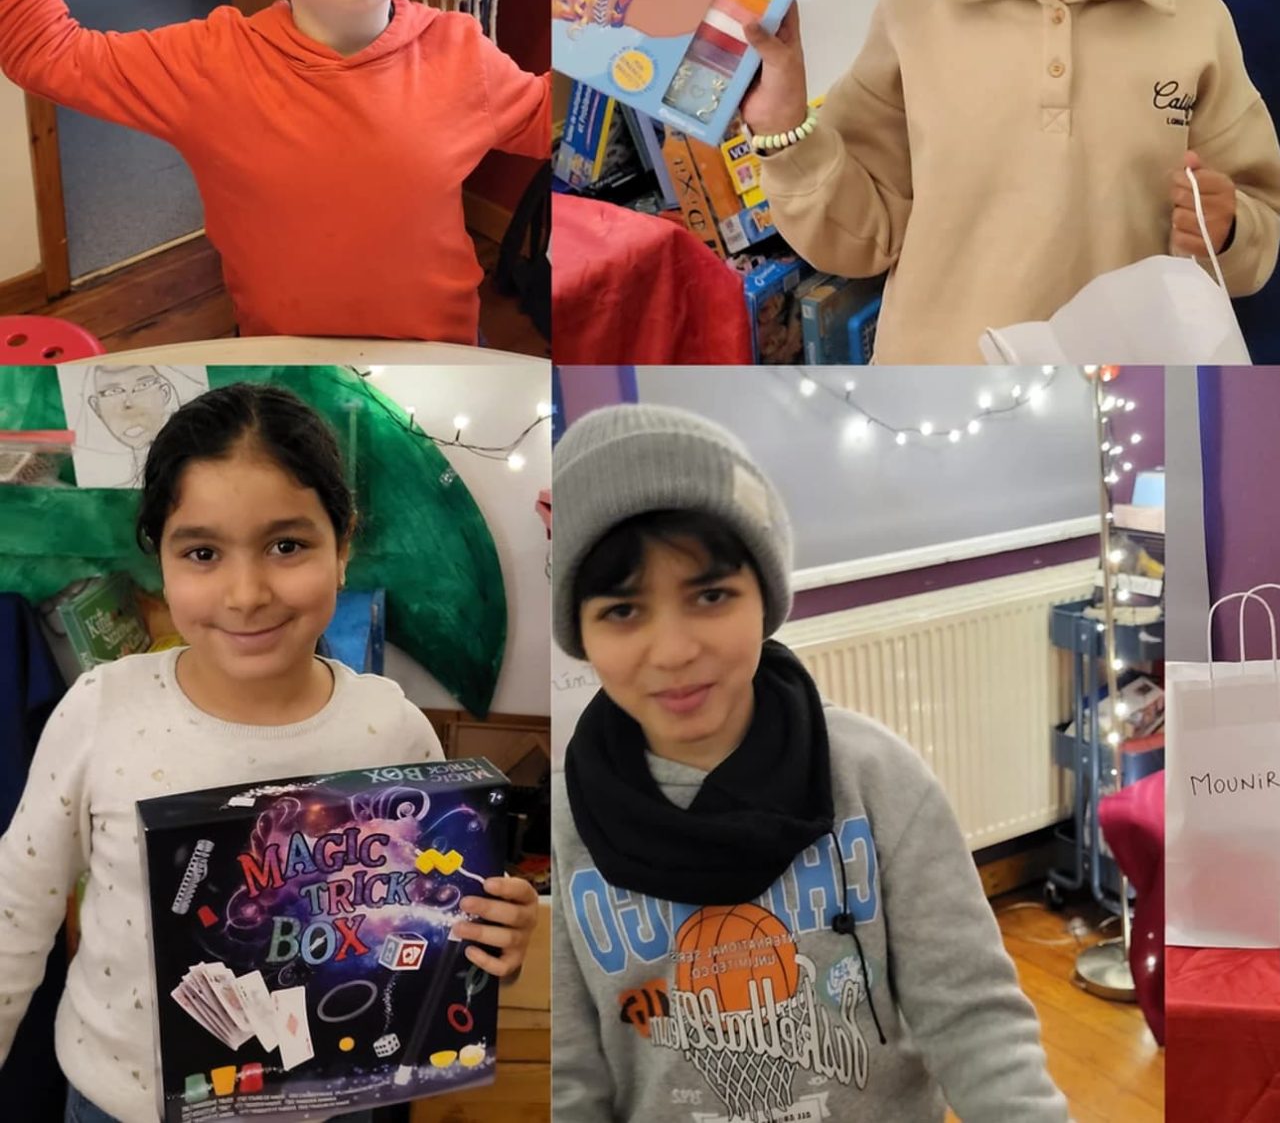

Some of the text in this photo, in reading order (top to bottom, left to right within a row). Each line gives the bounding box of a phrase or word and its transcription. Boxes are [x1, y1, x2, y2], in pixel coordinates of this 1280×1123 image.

[237, 827, 391, 899] MAGIC
[300, 871, 419, 917] TRICK
[265, 913, 369, 966] BOX
